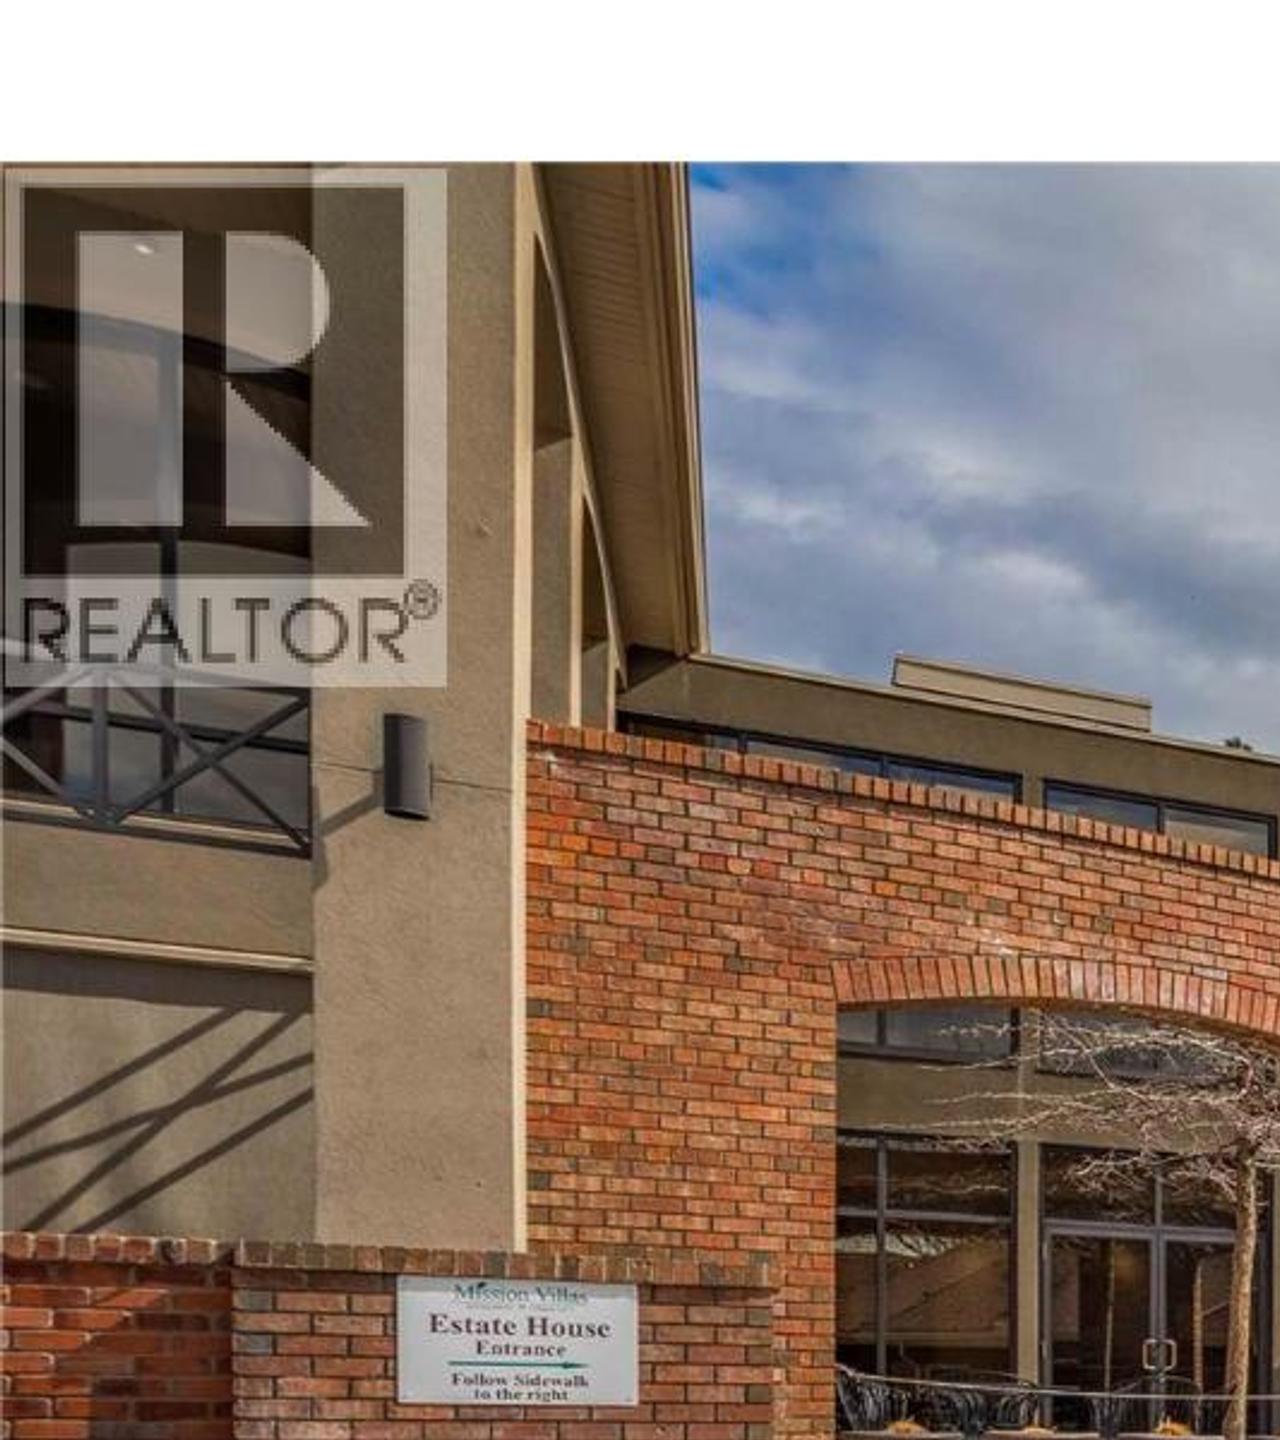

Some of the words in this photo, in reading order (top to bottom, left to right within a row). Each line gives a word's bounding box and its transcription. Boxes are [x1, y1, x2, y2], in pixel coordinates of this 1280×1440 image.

[454, 1282, 529, 1301] Mission
[535, 1287, 588, 1305] Villas
[429, 1313, 517, 1336] Estate
[527, 1316, 611, 1338] House
[476, 1340, 566, 1357] Entrance
[452, 1373, 506, 1387] Follow
[514, 1375, 589, 1387] Sidewalk
[473, 1389, 485, 1400] to
[496, 1389, 521, 1401] the
[527, 1390, 568, 1403] right
